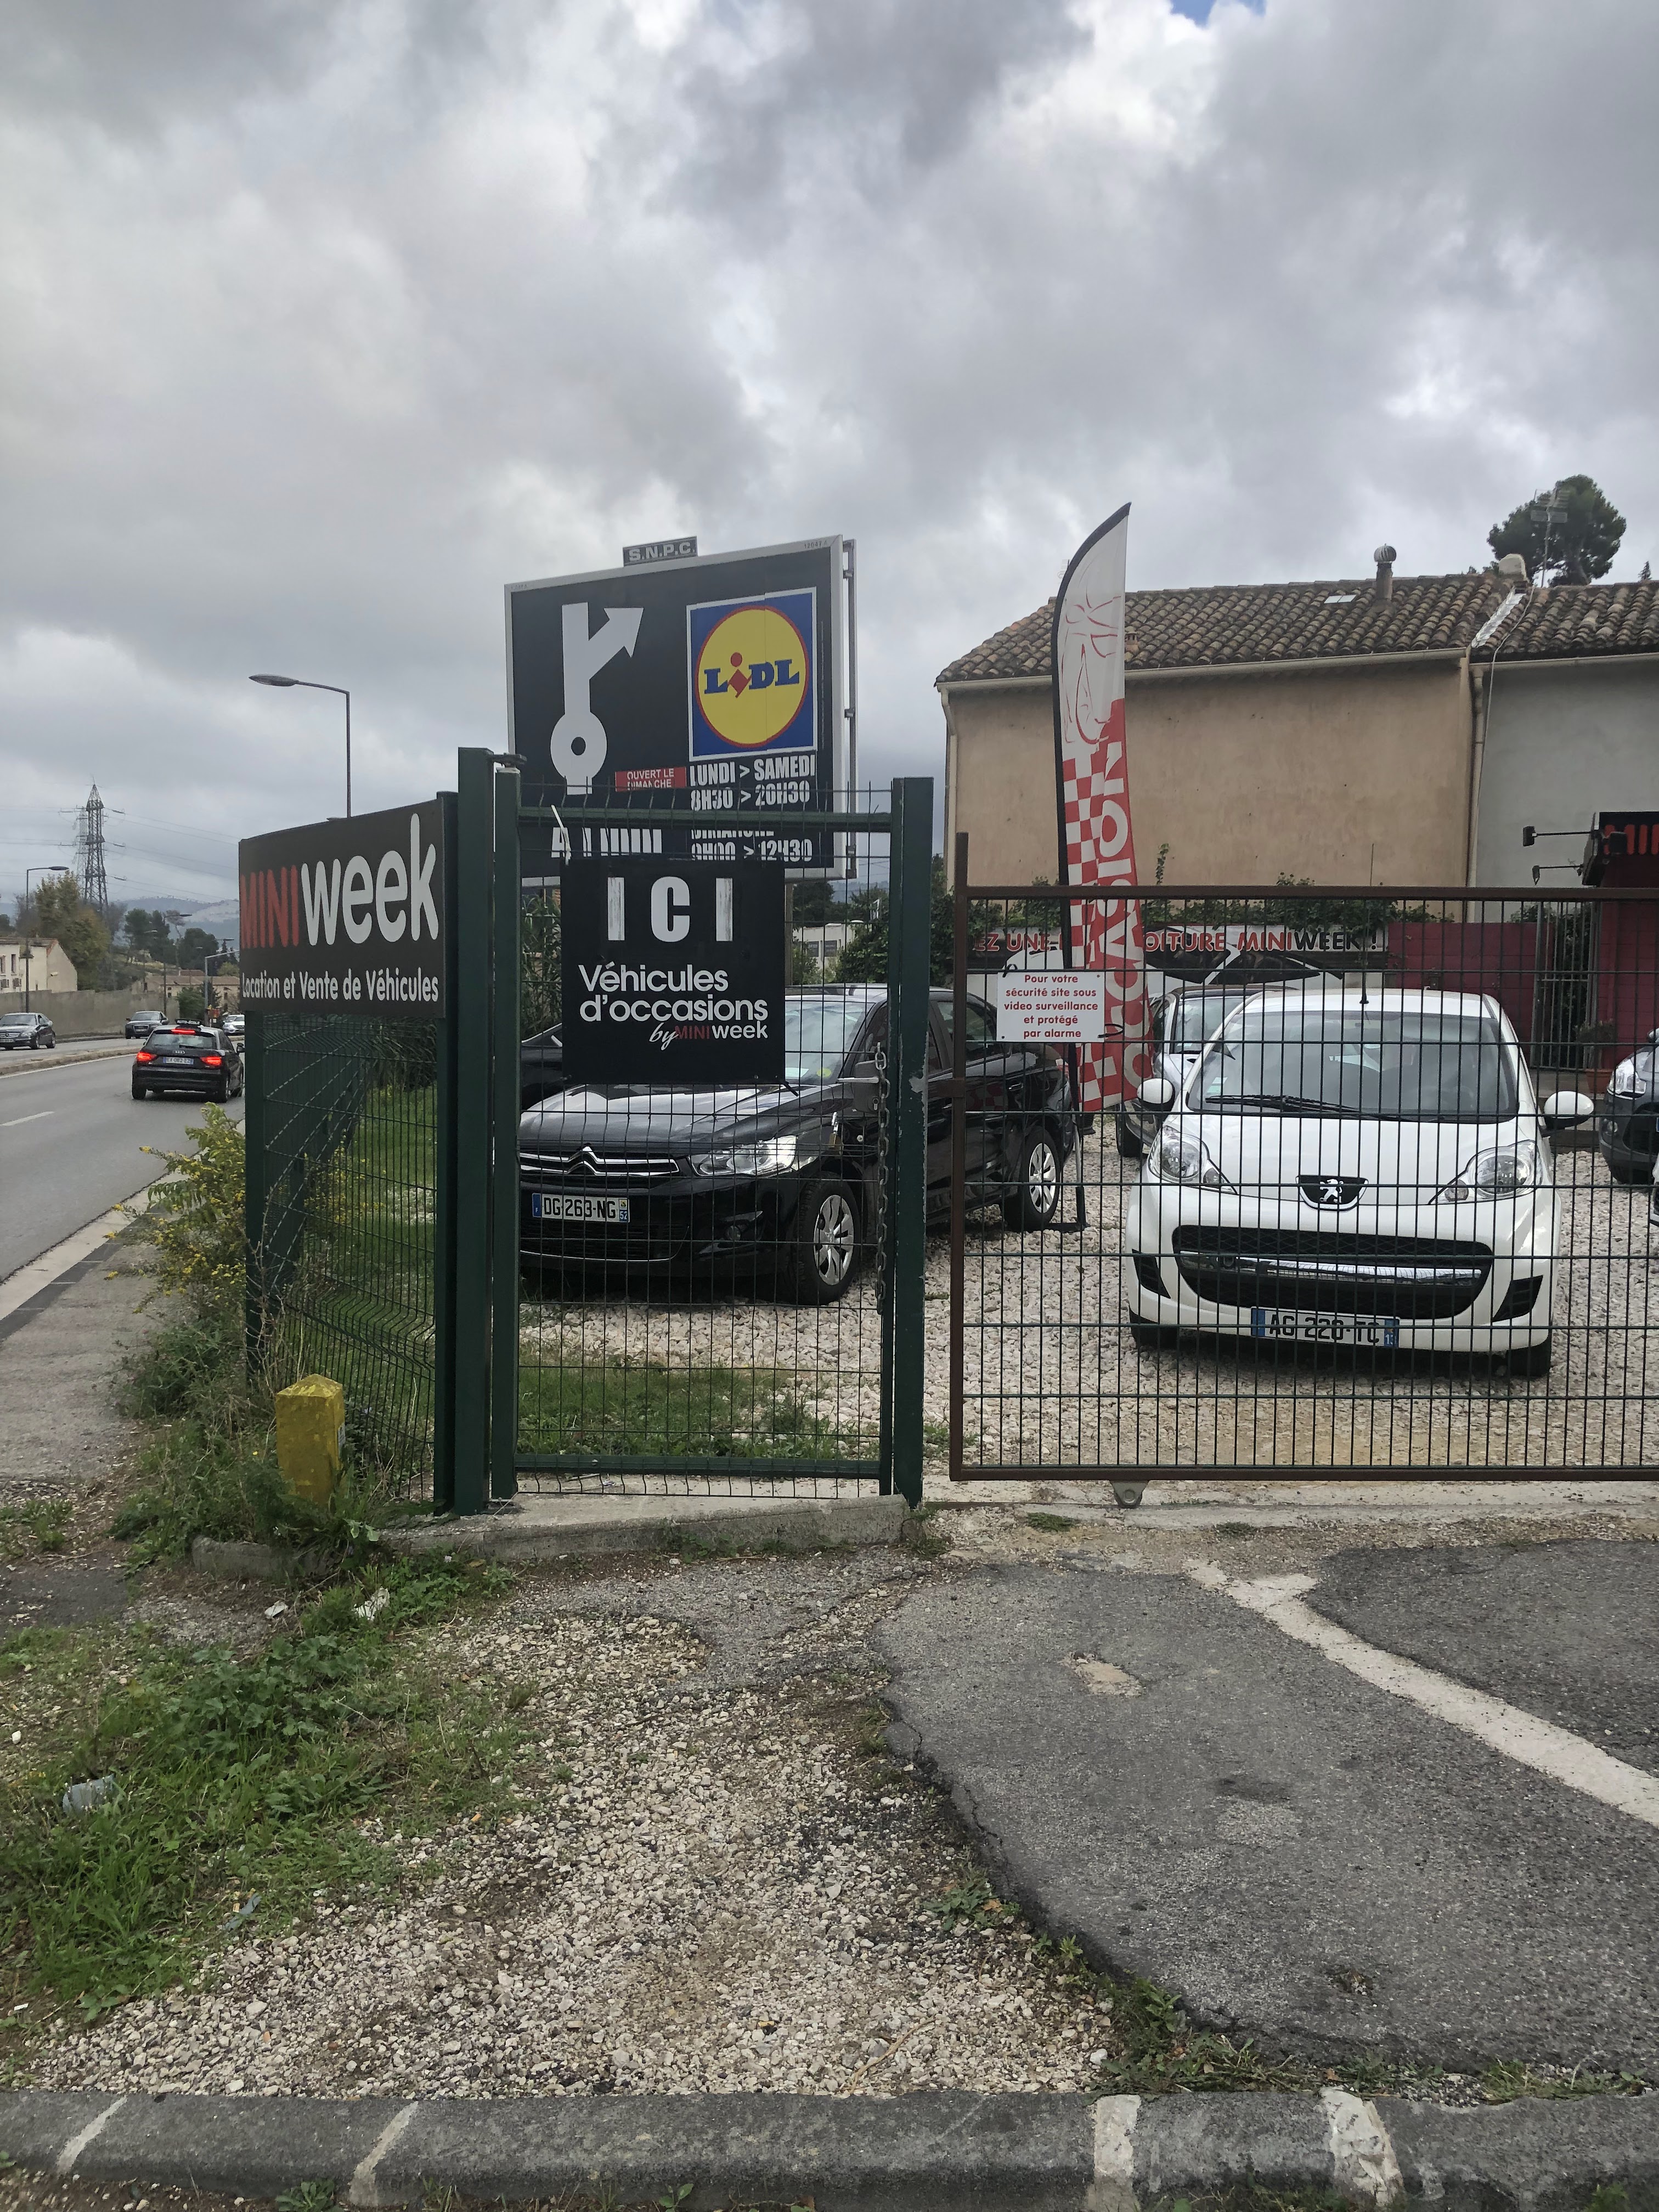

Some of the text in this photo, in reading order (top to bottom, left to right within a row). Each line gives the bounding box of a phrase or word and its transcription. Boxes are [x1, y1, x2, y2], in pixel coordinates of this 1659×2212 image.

[629, 542, 695, 561] S.N.P.C.
[627, 768, 674, 780] OUVERT LE
[690, 761, 736, 787] LUNDI
[754, 754, 815, 781] SAMEDI
[627, 778, 672, 791] DIMANCHE
[691, 787, 733, 811] 8H30
[755, 780, 810, 806] 20H30
[758, 839, 812, 862] 12H30
[1006, 933, 1051, 951] UNE
[1144, 932, 1225, 952] OITURE
[242, 967, 439, 1002] Location et Vente de Véhicules
[578, 961, 729, 992] Véhicules
[1024, 974, 1048, 983] Pour
[1006, 988, 1047, 996] sécurité
[1051, 988, 1070, 996] site
[579, 994, 768, 1022] d'occasions
[1004, 1001, 1098, 1010] video surveillance
[1024, 1015, 1078, 1026] et protégé
[649, 1023, 680, 1050] by
[1024, 1029, 1081, 1039] par alarme
[1269, 1314, 1380, 1343] AG220-TC
